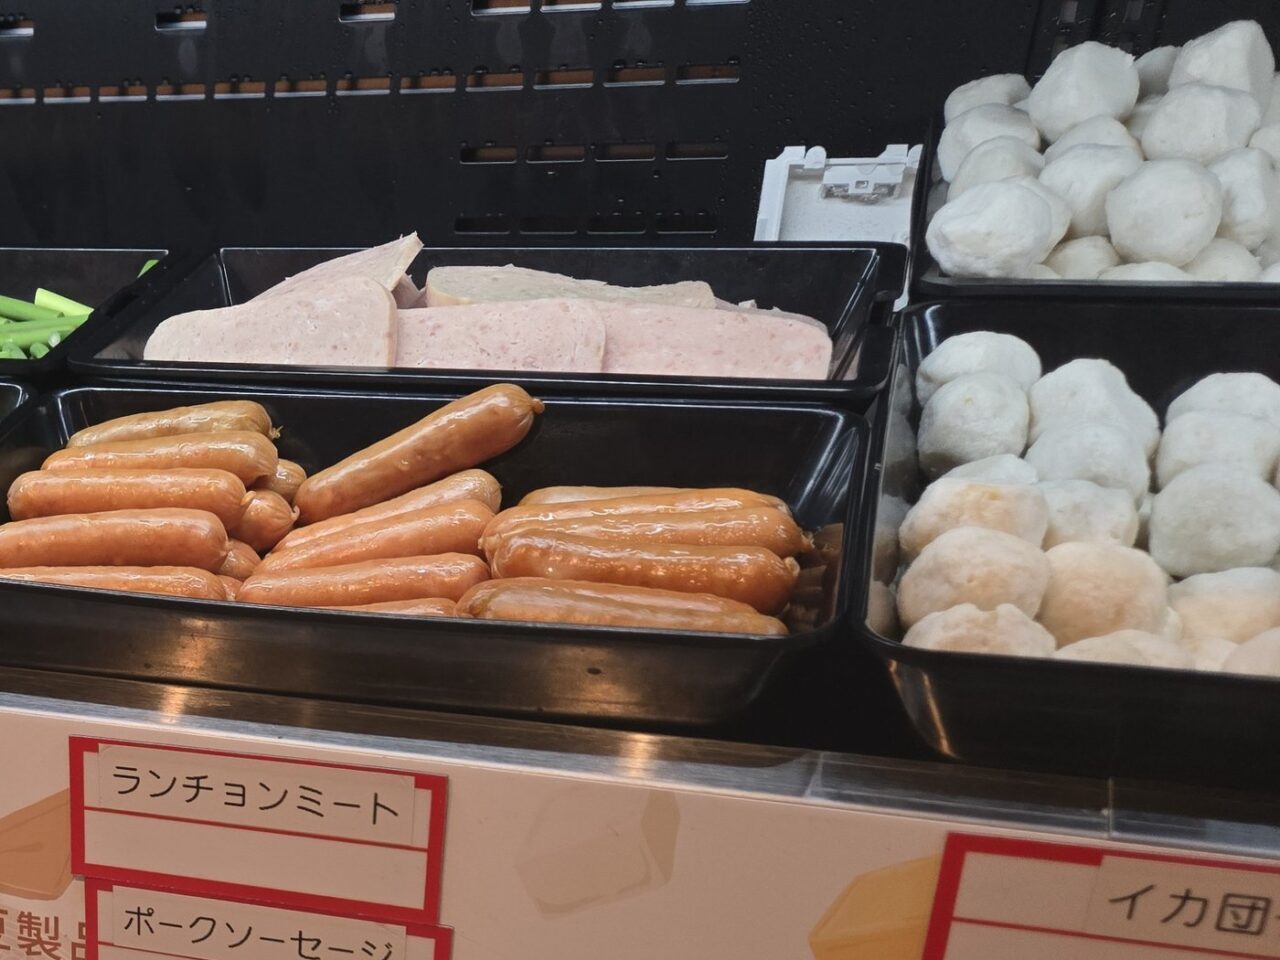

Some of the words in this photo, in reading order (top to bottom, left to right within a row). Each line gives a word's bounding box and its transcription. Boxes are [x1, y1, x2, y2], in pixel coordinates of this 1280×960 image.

[113, 765, 399, 825] ランチョンミート
[1108, 884, 1280, 936] イカ団
